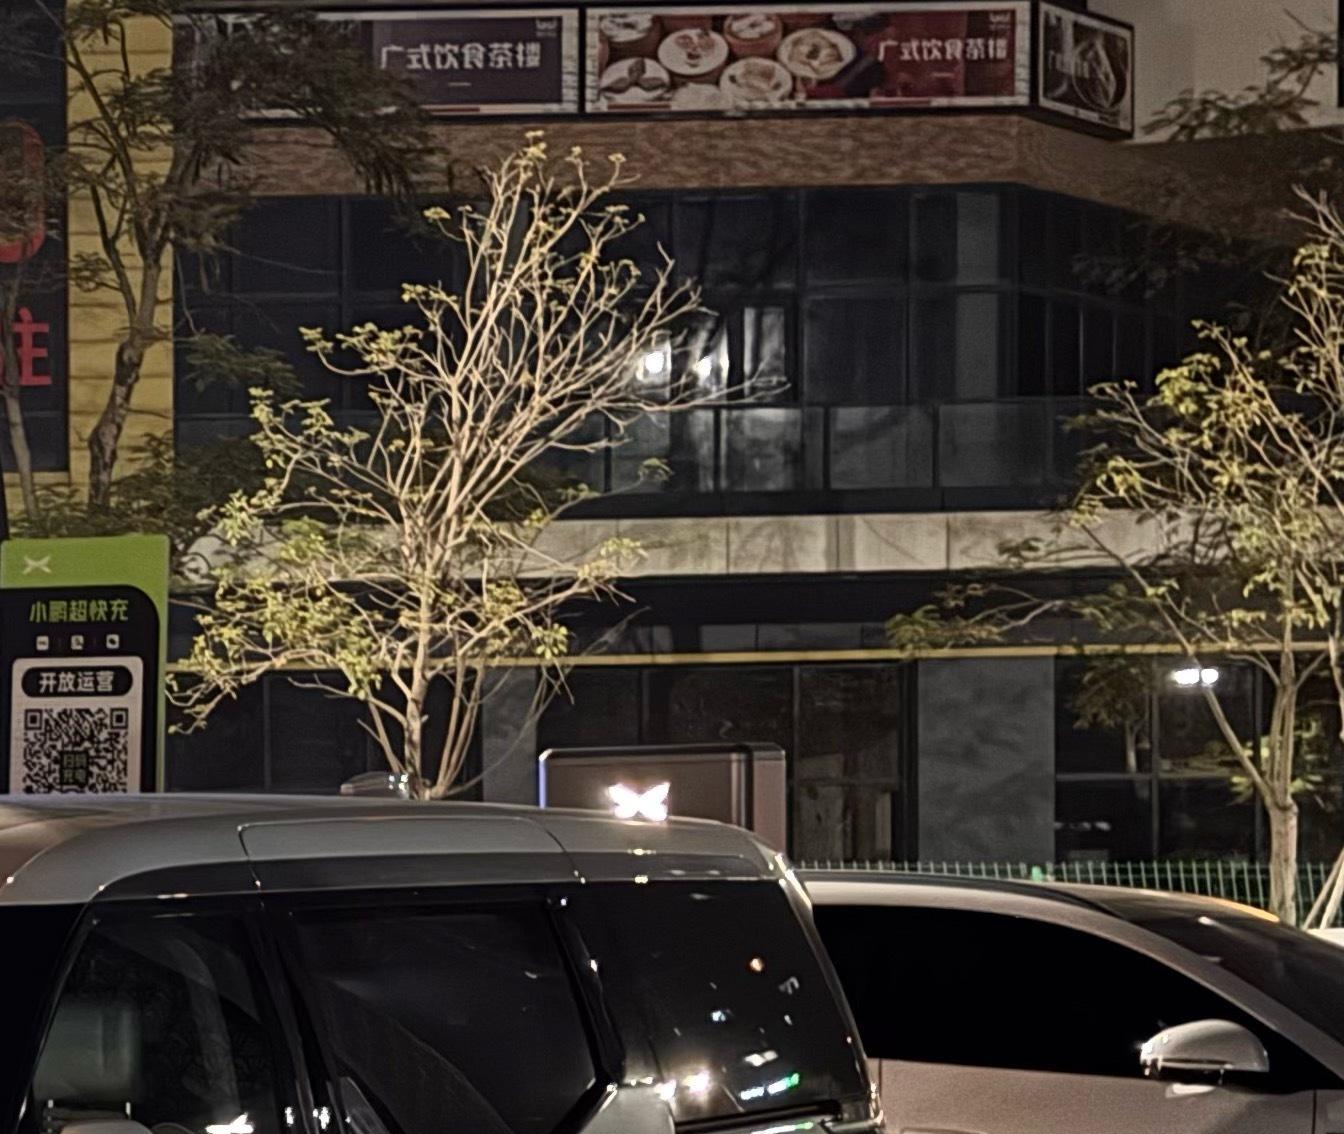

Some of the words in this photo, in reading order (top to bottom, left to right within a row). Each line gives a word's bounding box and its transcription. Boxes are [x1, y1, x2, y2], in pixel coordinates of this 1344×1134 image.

[28, 600, 129, 624] 小鹏超快充
[38, 671, 115, 694] 开放运营
